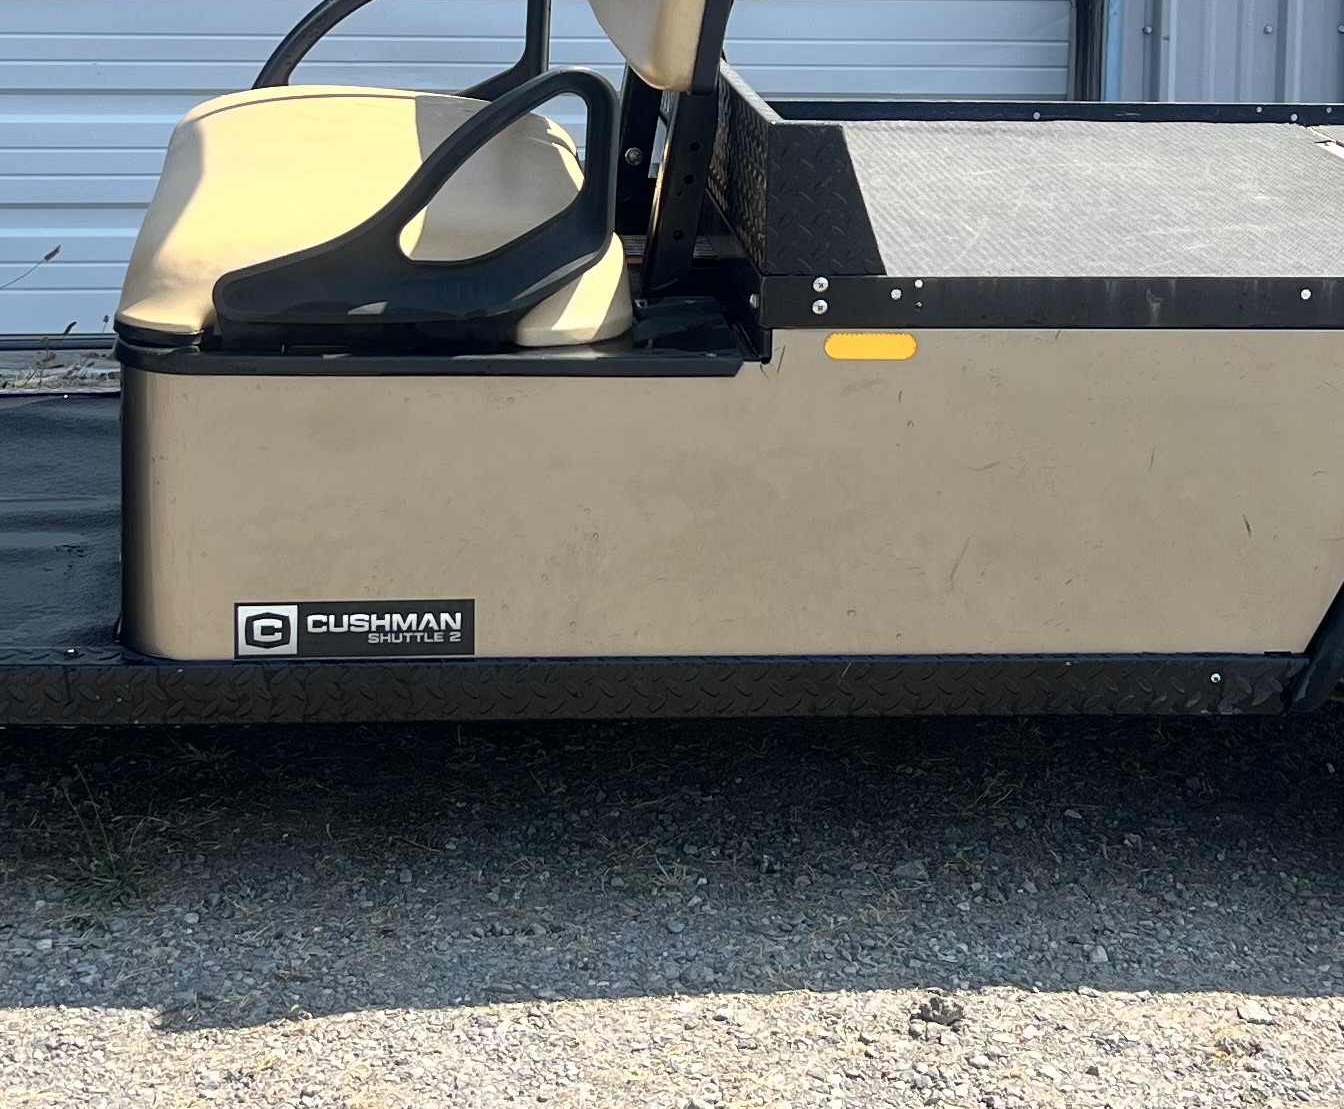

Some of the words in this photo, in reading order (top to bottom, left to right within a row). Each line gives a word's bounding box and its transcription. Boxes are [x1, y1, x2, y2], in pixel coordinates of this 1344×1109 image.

[253, 618, 283, 642] C
[306, 612, 462, 633] CUSHMAN
[367, 632, 444, 644] SHUTTLE
[449, 631, 461, 642] 2
